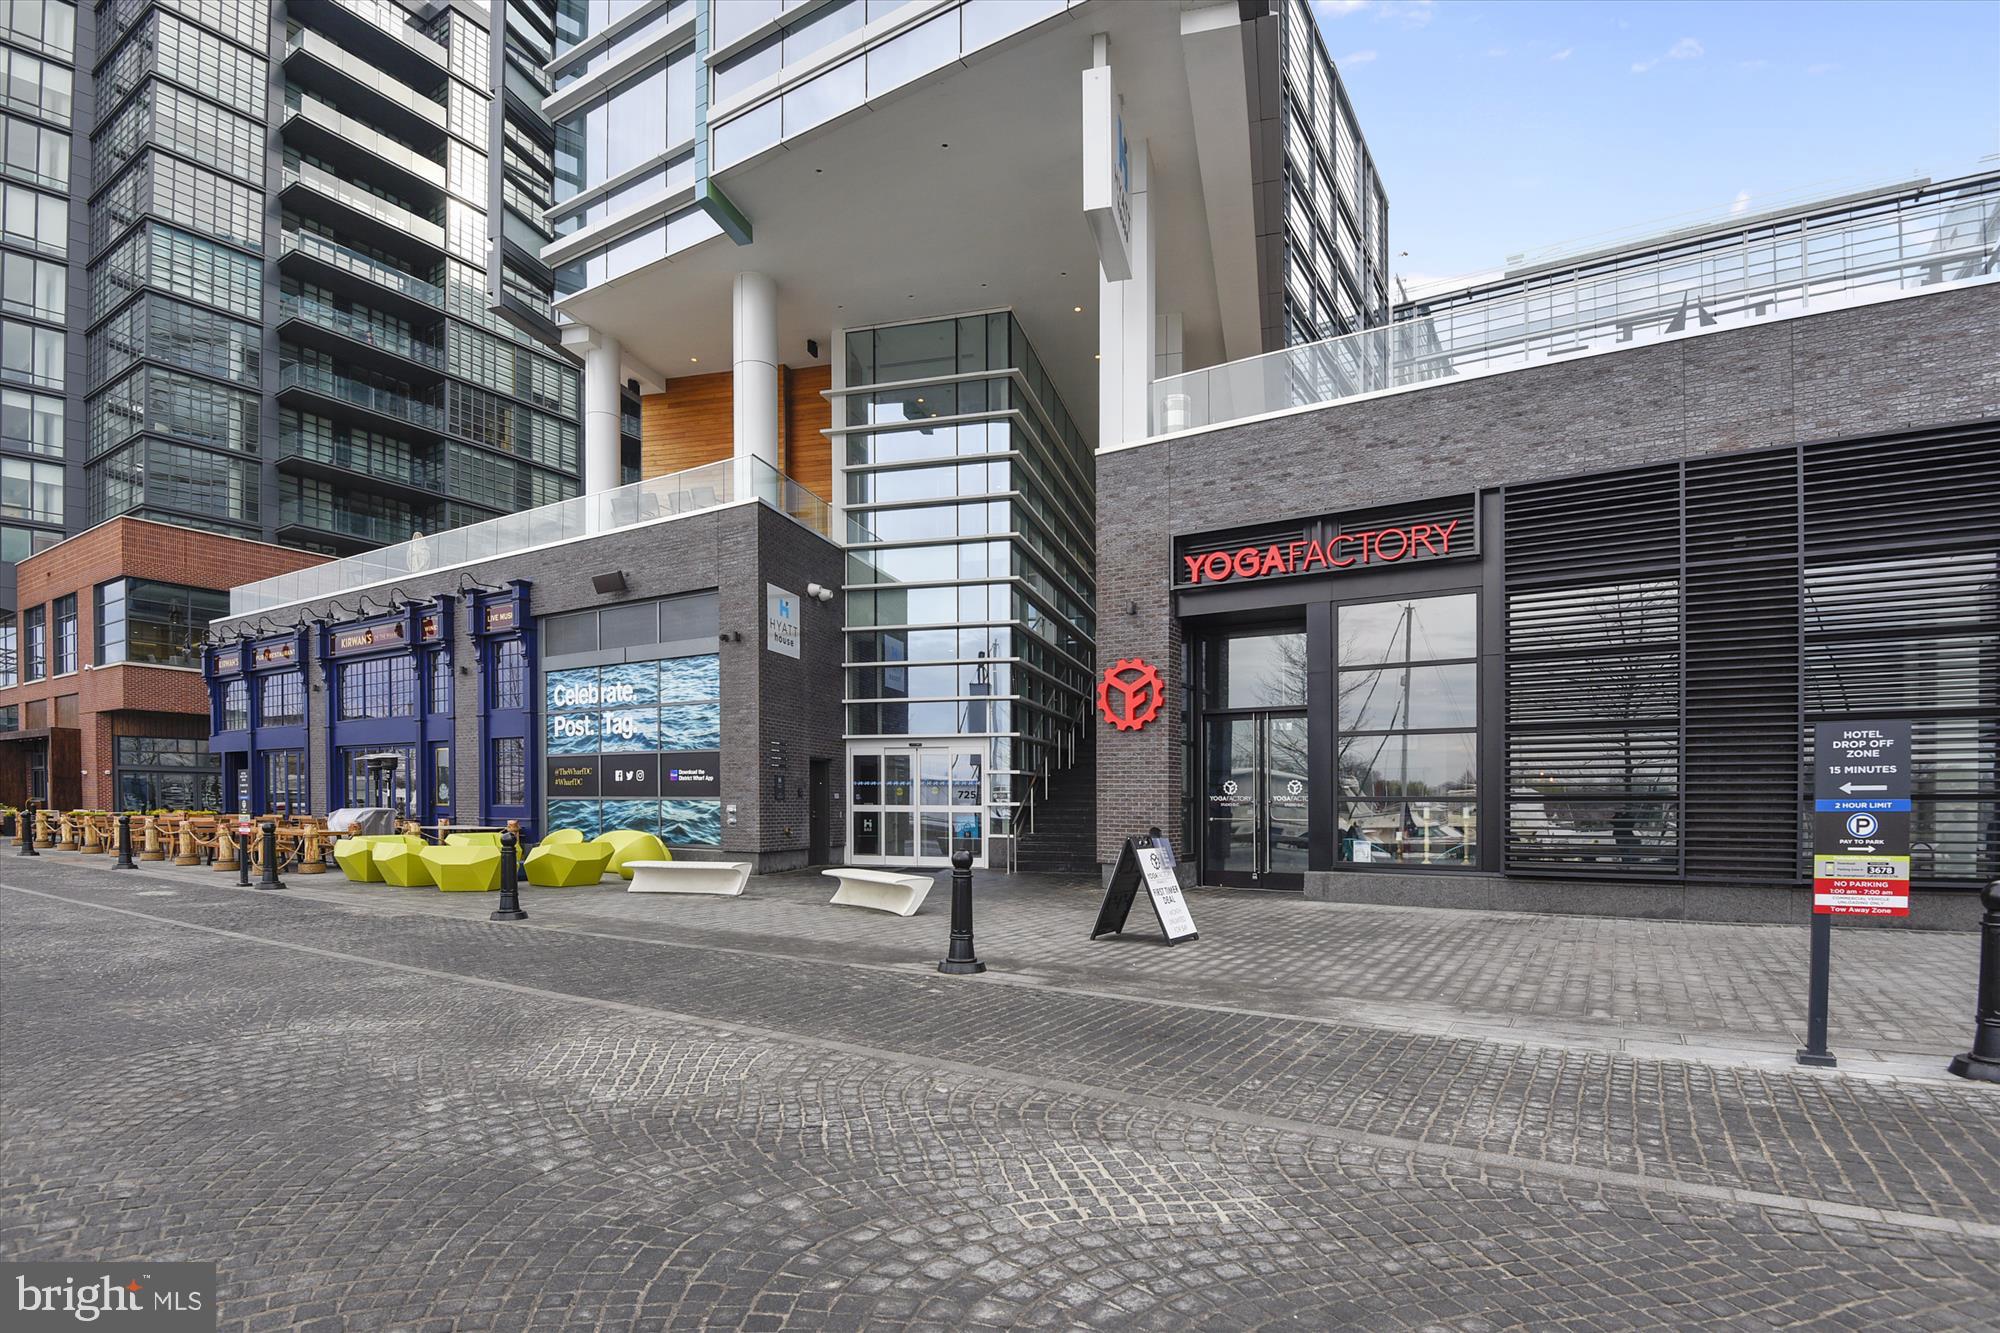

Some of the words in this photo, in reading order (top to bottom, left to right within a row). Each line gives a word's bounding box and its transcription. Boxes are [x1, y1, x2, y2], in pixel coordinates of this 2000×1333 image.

[487, 613, 499, 622] LIVE
[499, 611, 513, 621] MUSI
[769, 617, 798, 638] HYATT
[341, 634, 372, 649] KIRWAN'S
[774, 631, 795, 647] house
[554, 681, 637, 706] Celebrate.
[554, 715, 594, 737] Post.
[602, 711, 637, 739] Tag.
[1843, 730, 1884, 739] HOTEL
[1832, 740, 1867, 749] DROP
[1869, 739, 1895, 748] OFF
[1846, 749, 1880, 758] ZONE
[1829, 766, 1841, 774] 15
[1844, 765, 1897, 774] MINUTES
[957, 790, 977, 799] 725
[1855, 818, 1871, 833] P
[1153, 887, 1164, 897] FIRST
[1163, 895, 1176, 905] DEAL
